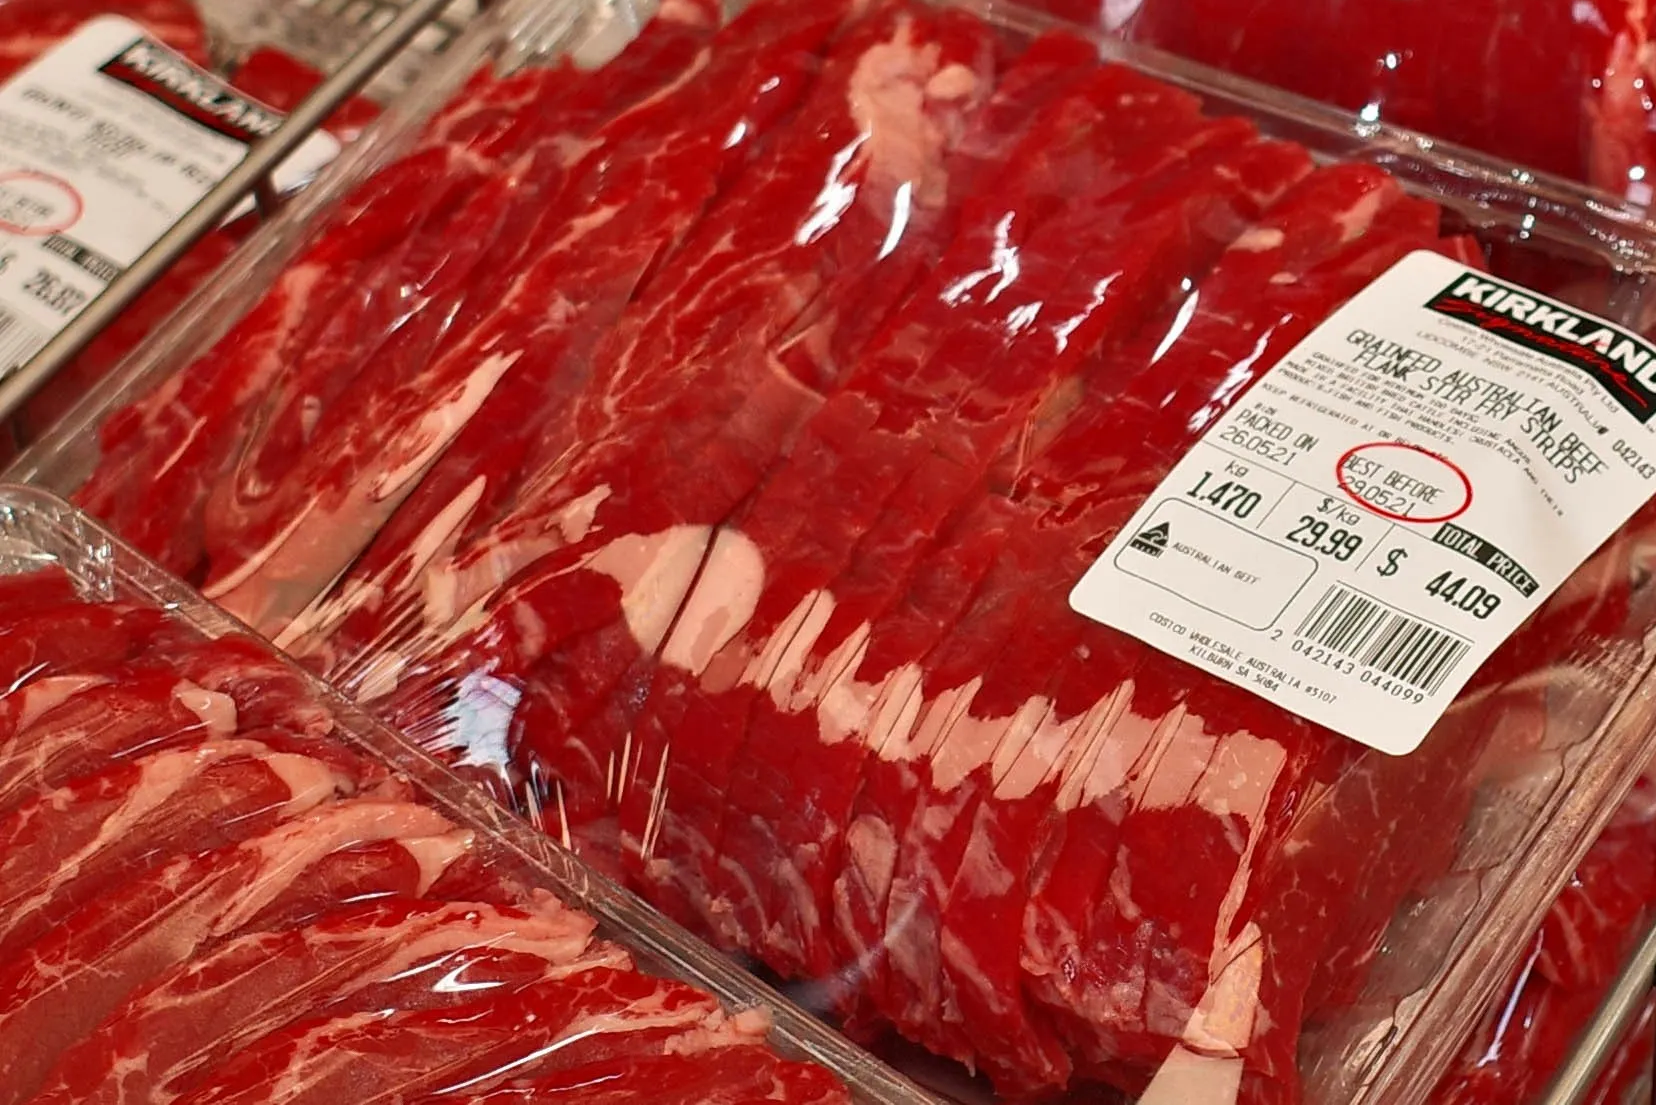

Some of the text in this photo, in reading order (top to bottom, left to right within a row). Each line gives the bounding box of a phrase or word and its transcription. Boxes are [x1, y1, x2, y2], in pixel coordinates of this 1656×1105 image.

[1234, 408, 1319, 452] PACKED ON
[1345, 327, 1609, 474] GRAINFED AUSTRALIAN BEEF
[1352, 350, 1584, 484] FLANK STIR FRY STRIPS
[1223, 460, 1362, 527] kg $/kg
[1341, 454, 1445, 505] BEST BEFORE
[1171, 542, 1232, 574] AUSTRALIAN
[1185, 470, 1502, 621] 1.470 29.99 $ 44.09
[1435, 524, 1536, 594] TOTAL PRICE
[1147, 611, 1338, 704] COSTCO WHOLESALE AUSTRALIA #5107
[1187, 644, 1280, 692] KILBURN SA 5084
[1269, 627, 1425, 705] 2 042143 044099
